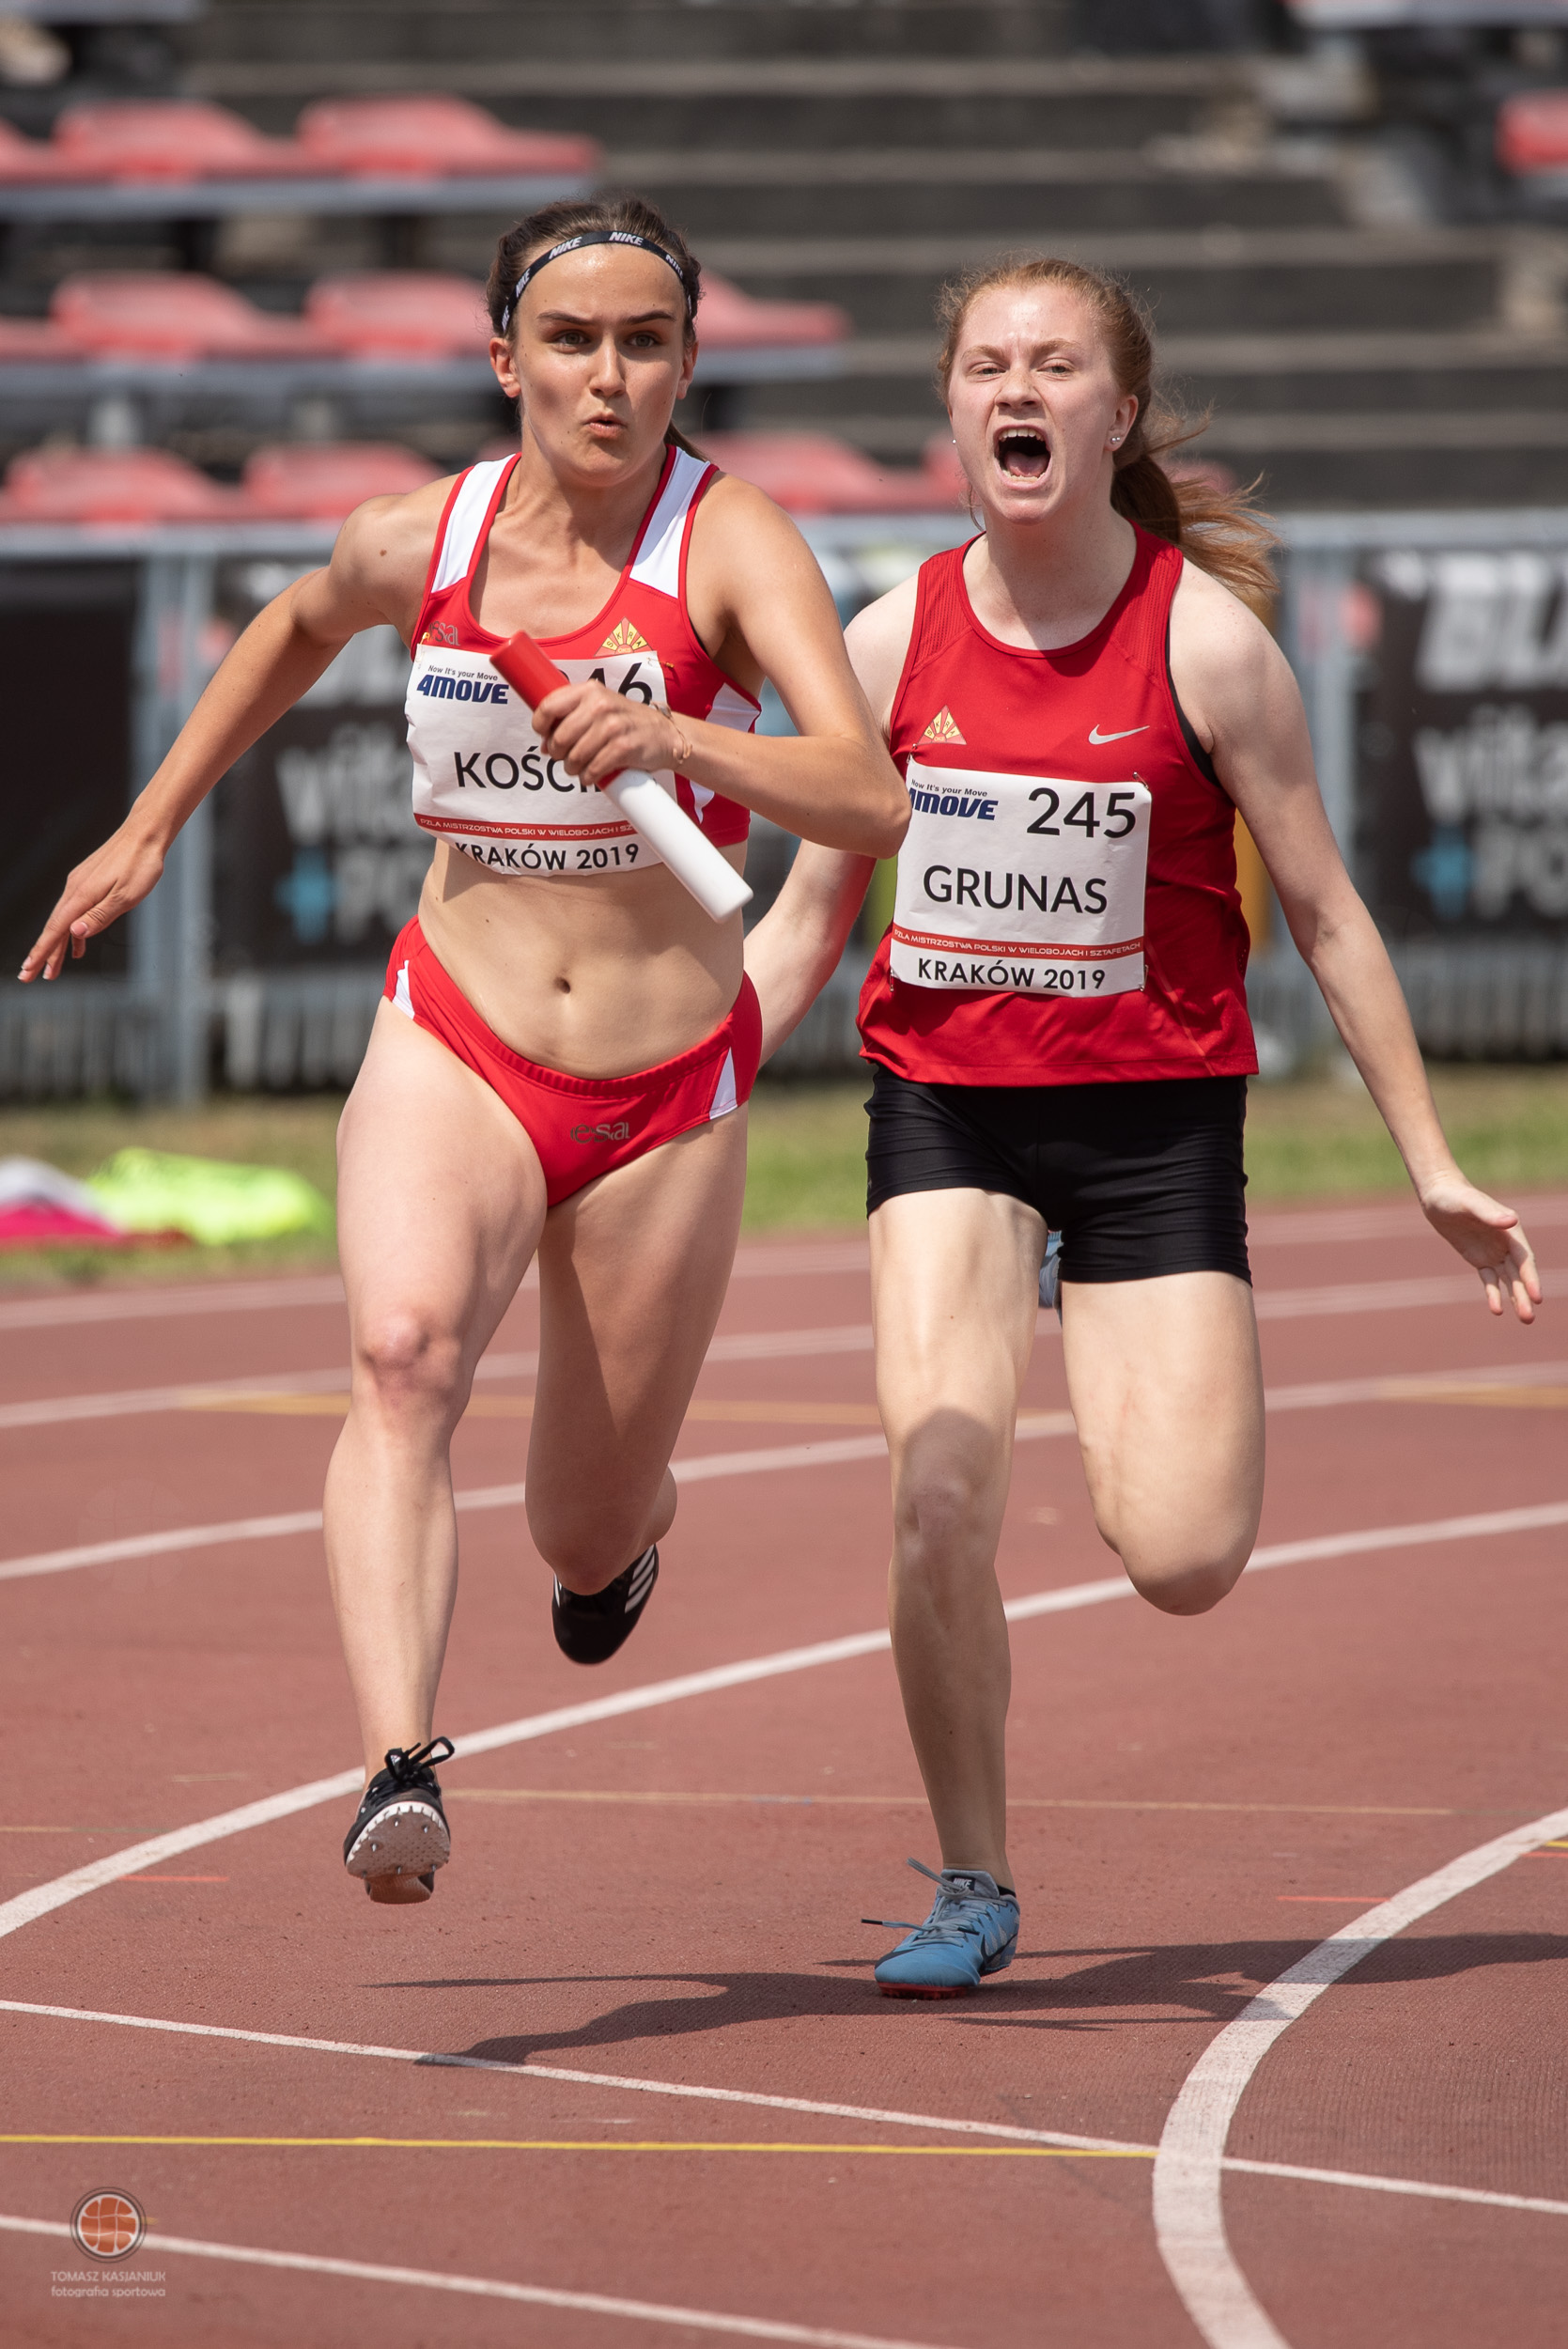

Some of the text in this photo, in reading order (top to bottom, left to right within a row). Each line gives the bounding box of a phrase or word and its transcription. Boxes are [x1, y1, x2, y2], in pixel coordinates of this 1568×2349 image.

[548, 236, 582, 259] NIKE
[609, 231, 644, 246] NIKE
[665, 254, 684, 280] NIKE
[516, 268, 531, 298] NIKE
[428, 665, 499, 681] Now It's your Move
[416, 674, 509, 705] 4MOVE
[454, 745, 602, 793] KOŚC
[910, 778, 988, 797] Now It's your Move
[1026, 786, 1137, 839] 245
[420, 818, 442, 827] PZLA
[442, 821, 504, 834] MISTRZOSTWA
[548, 827, 614, 836] WIELOBOJACH
[576, 843, 639, 870] 2019
[924, 864, 1108, 914] GRUNAS
[894, 928, 910, 940] PZLA
[910, 935, 972, 950] MISTRZOSTWA
[973, 943, 1006, 953] POLSKI
[1018, 947, 1084, 957] WIELOBOJACH
[1090, 941, 1141, 957] SZTAFETACH
[918, 957, 1106, 989] KRAKÓW 2019
[953, 1877, 972, 1890] NIKE
